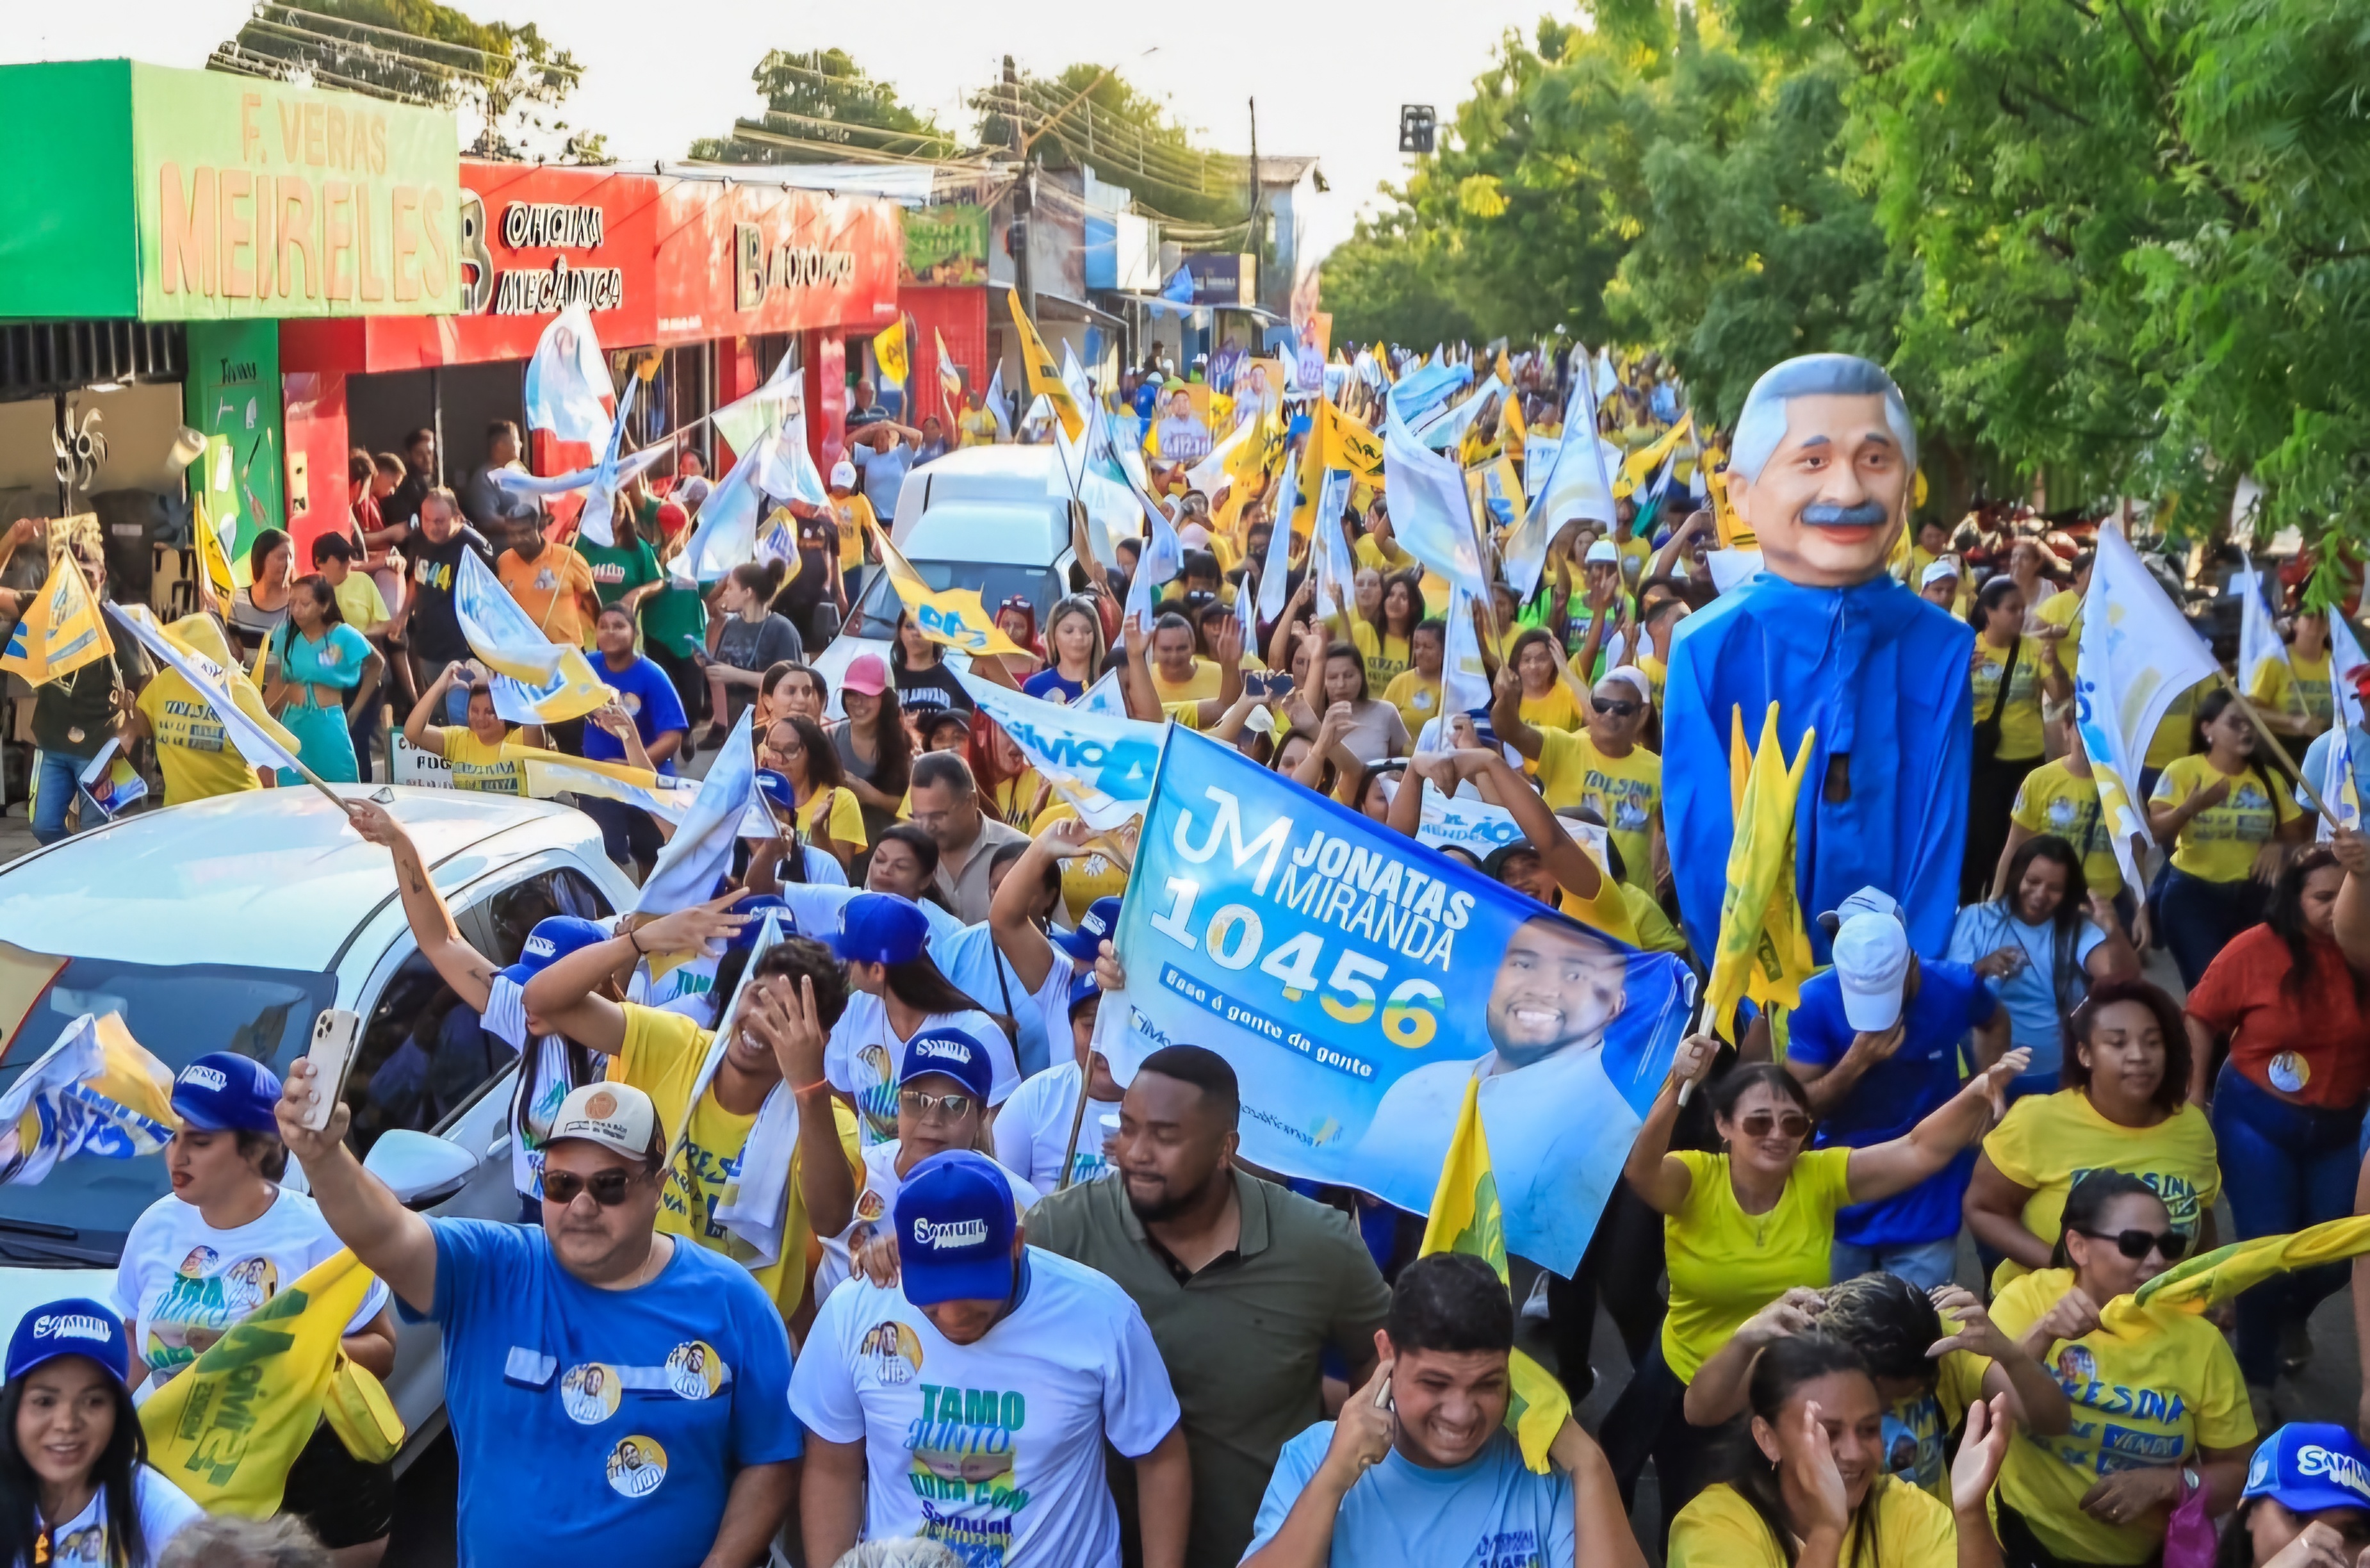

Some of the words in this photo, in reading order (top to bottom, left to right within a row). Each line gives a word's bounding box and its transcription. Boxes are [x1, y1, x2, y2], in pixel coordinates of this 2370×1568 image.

[278, 101, 387, 175] VERAS
[160, 161, 448, 302] MEIRELES
[1274, 862, 1456, 972] MIRANDA
[1292, 829, 1476, 930] JONATAS
[1150, 876, 1446, 1049] 10456
[1315, 1047, 1373, 1078] gente
[903, 1417, 1010, 1455] JUNTO
[920, 1384, 1026, 1431] TAMO
